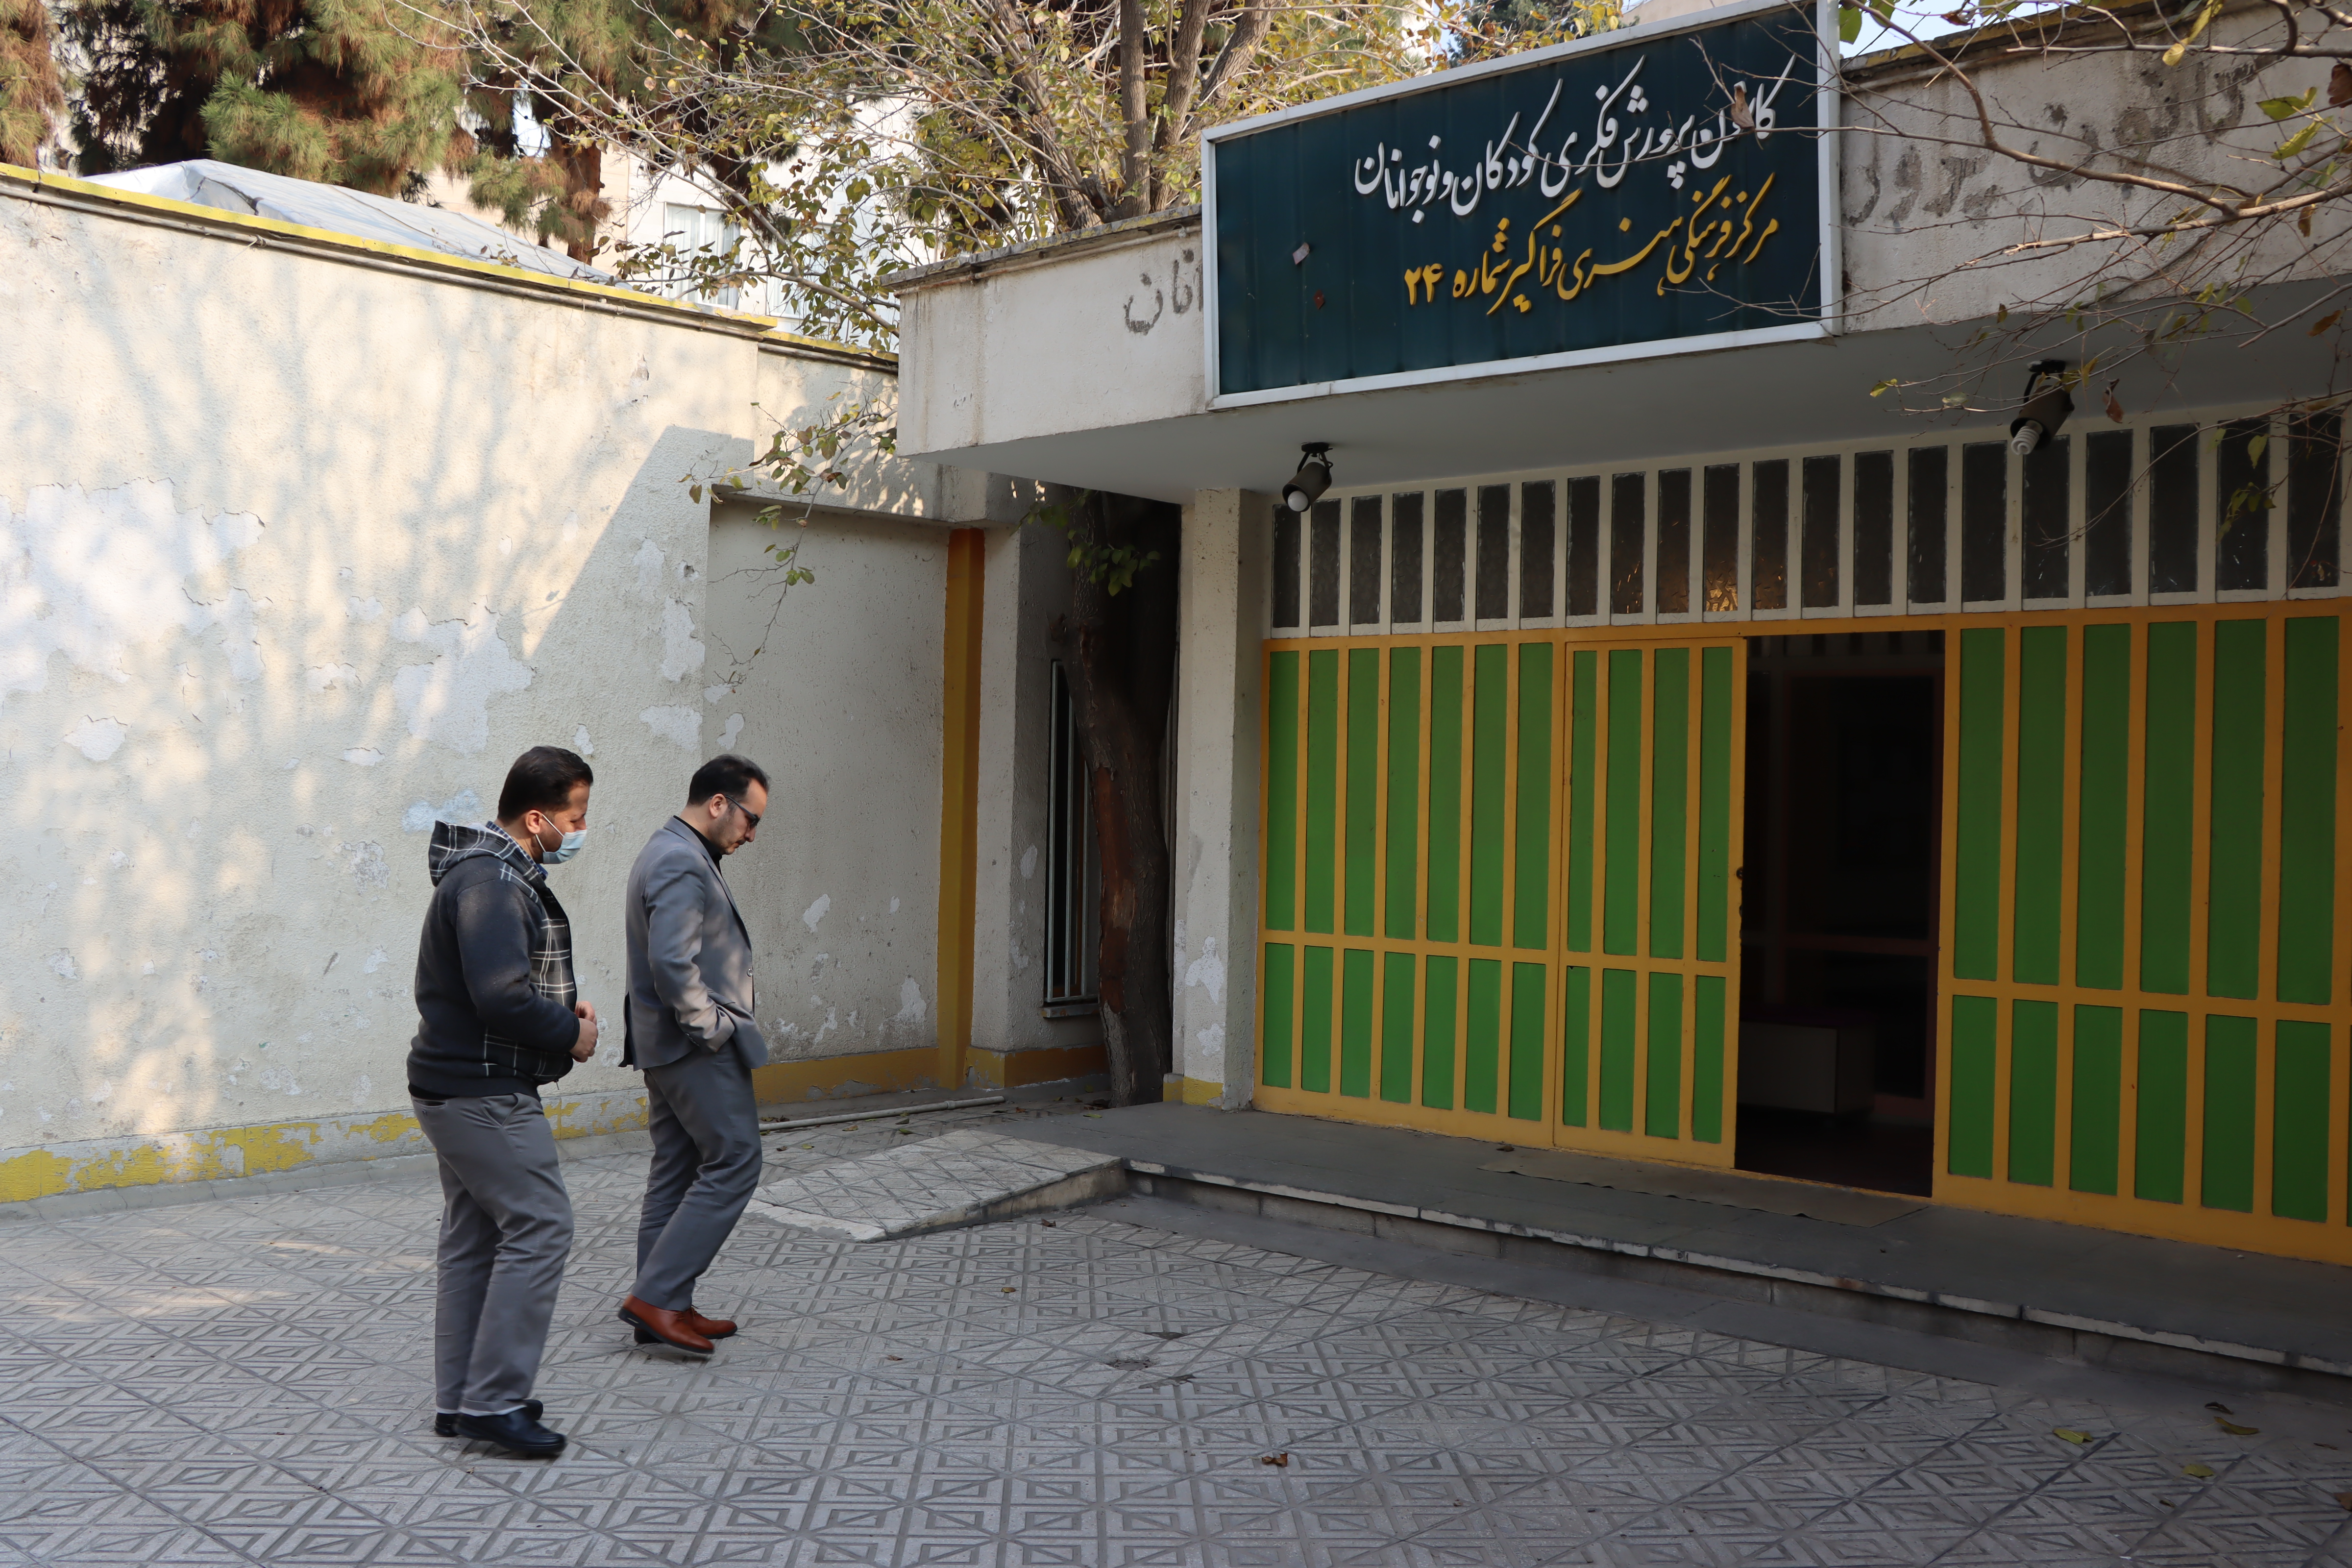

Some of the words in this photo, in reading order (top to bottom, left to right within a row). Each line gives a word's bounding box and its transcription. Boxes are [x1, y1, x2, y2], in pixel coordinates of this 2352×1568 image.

[1450, 78, 1563, 216] کودکان
[1541, 54, 1646, 197] فکری
[1596, 84, 1695, 190] پرورش
[1354, 134, 1442, 223] نوجوانان
[1438, 170, 1454, 200] و
[1724, 172, 1779, 264] مرکز
[1452, 217, 1512, 298] شماره
[1486, 188, 1583, 315] فراگیر
[1557, 216, 1684, 300] هنری
[1666, 174, 1733, 284] فرهنگی
[1404, 263, 1444, 306] ۲۴
